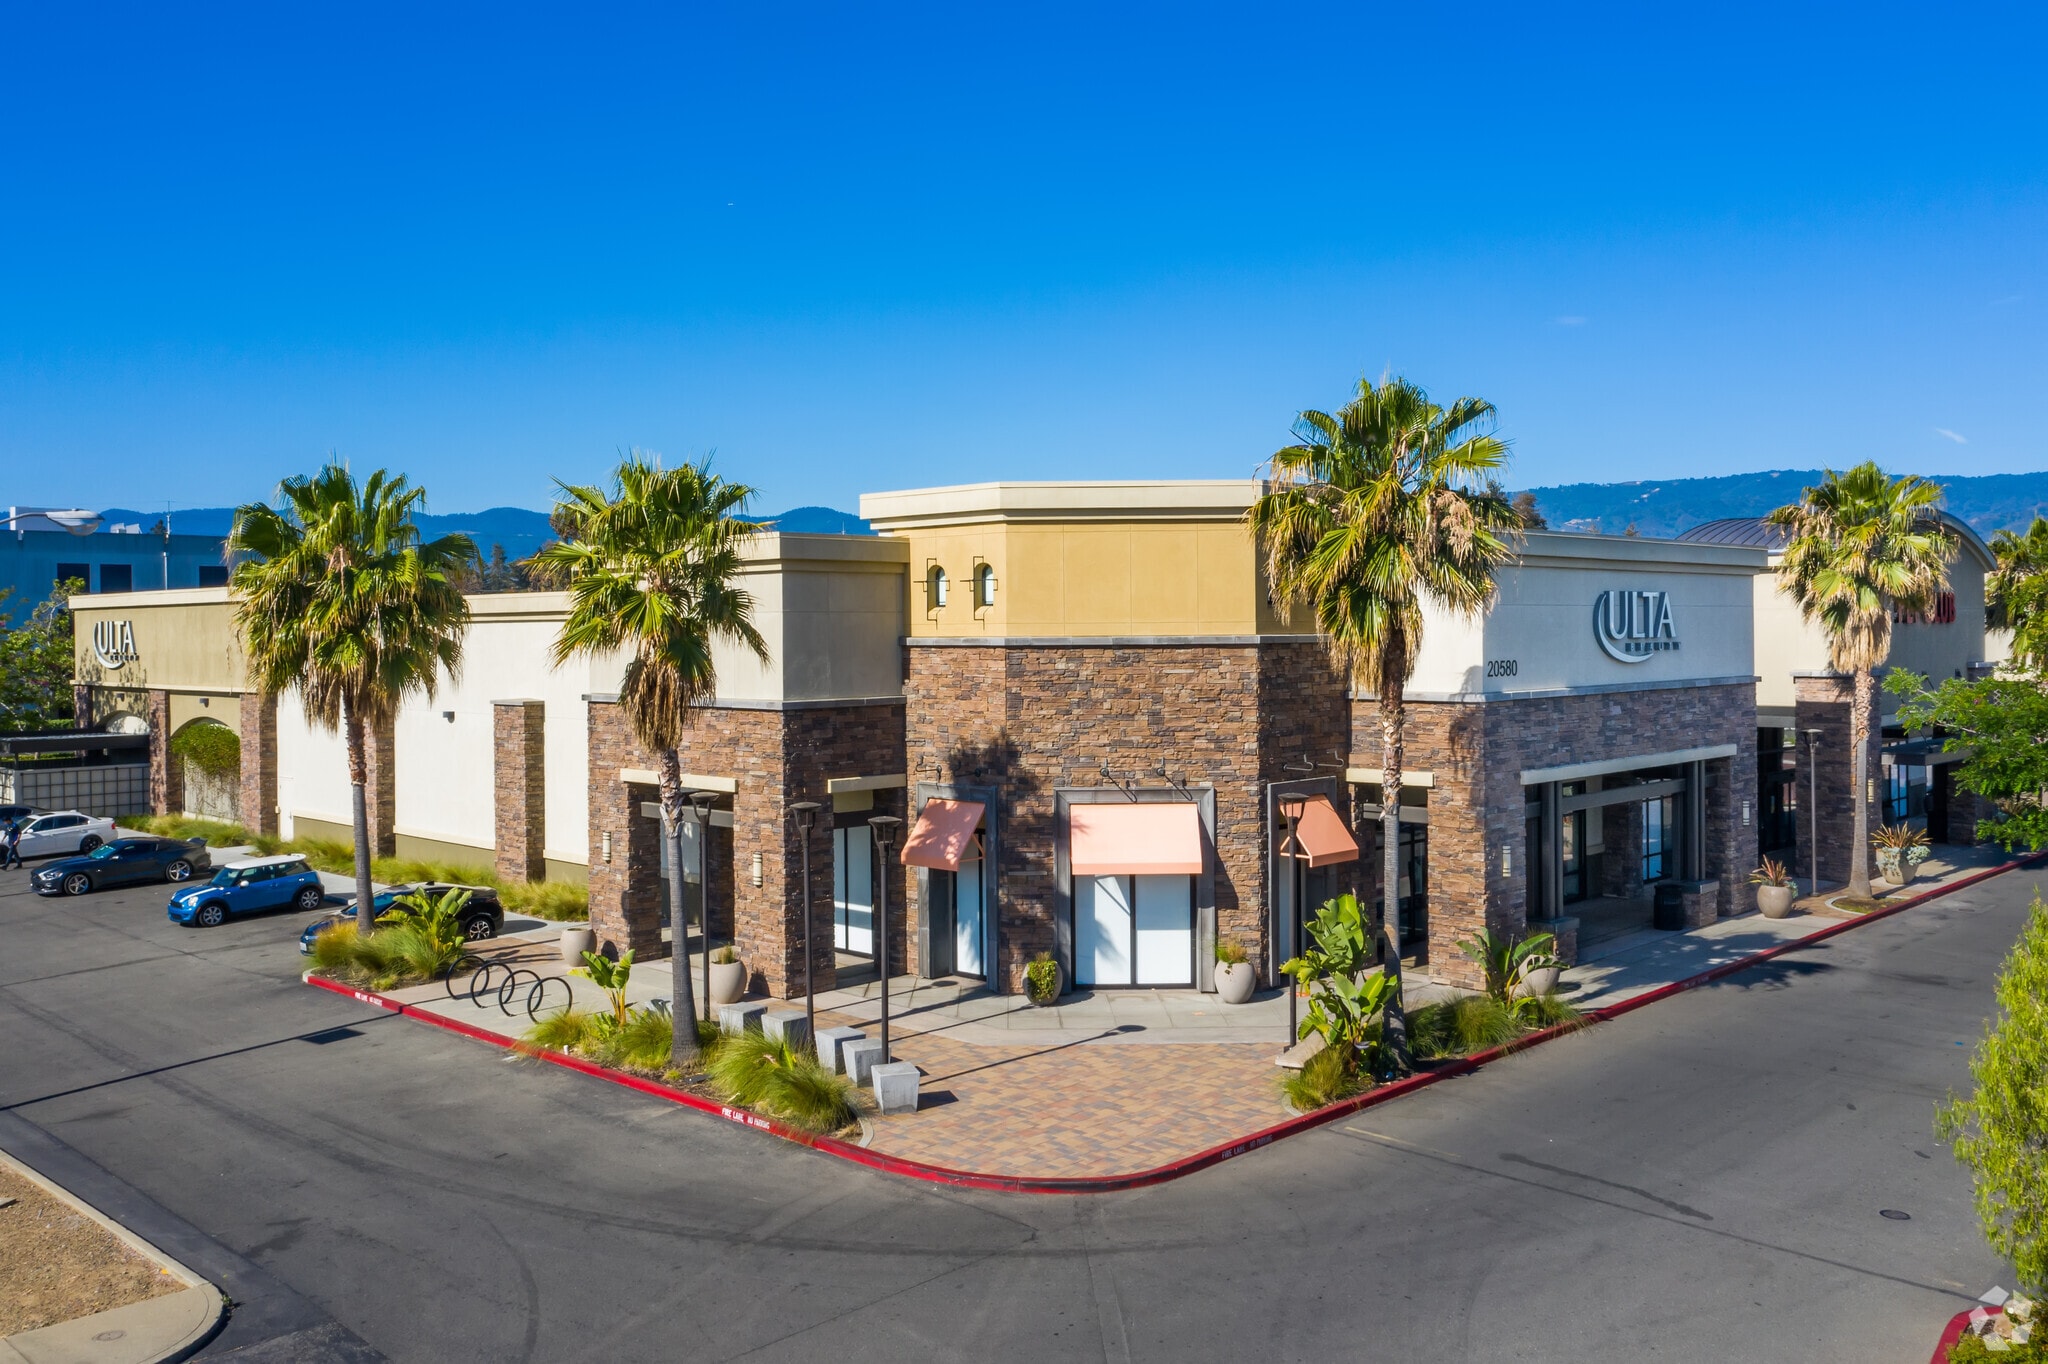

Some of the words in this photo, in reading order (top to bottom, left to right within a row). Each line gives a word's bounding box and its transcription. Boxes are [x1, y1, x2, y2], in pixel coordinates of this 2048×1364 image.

[1603, 590, 1677, 640] ULTA
[97, 620, 137, 655] ULTA
[1487, 659, 1518, 677] 20580
